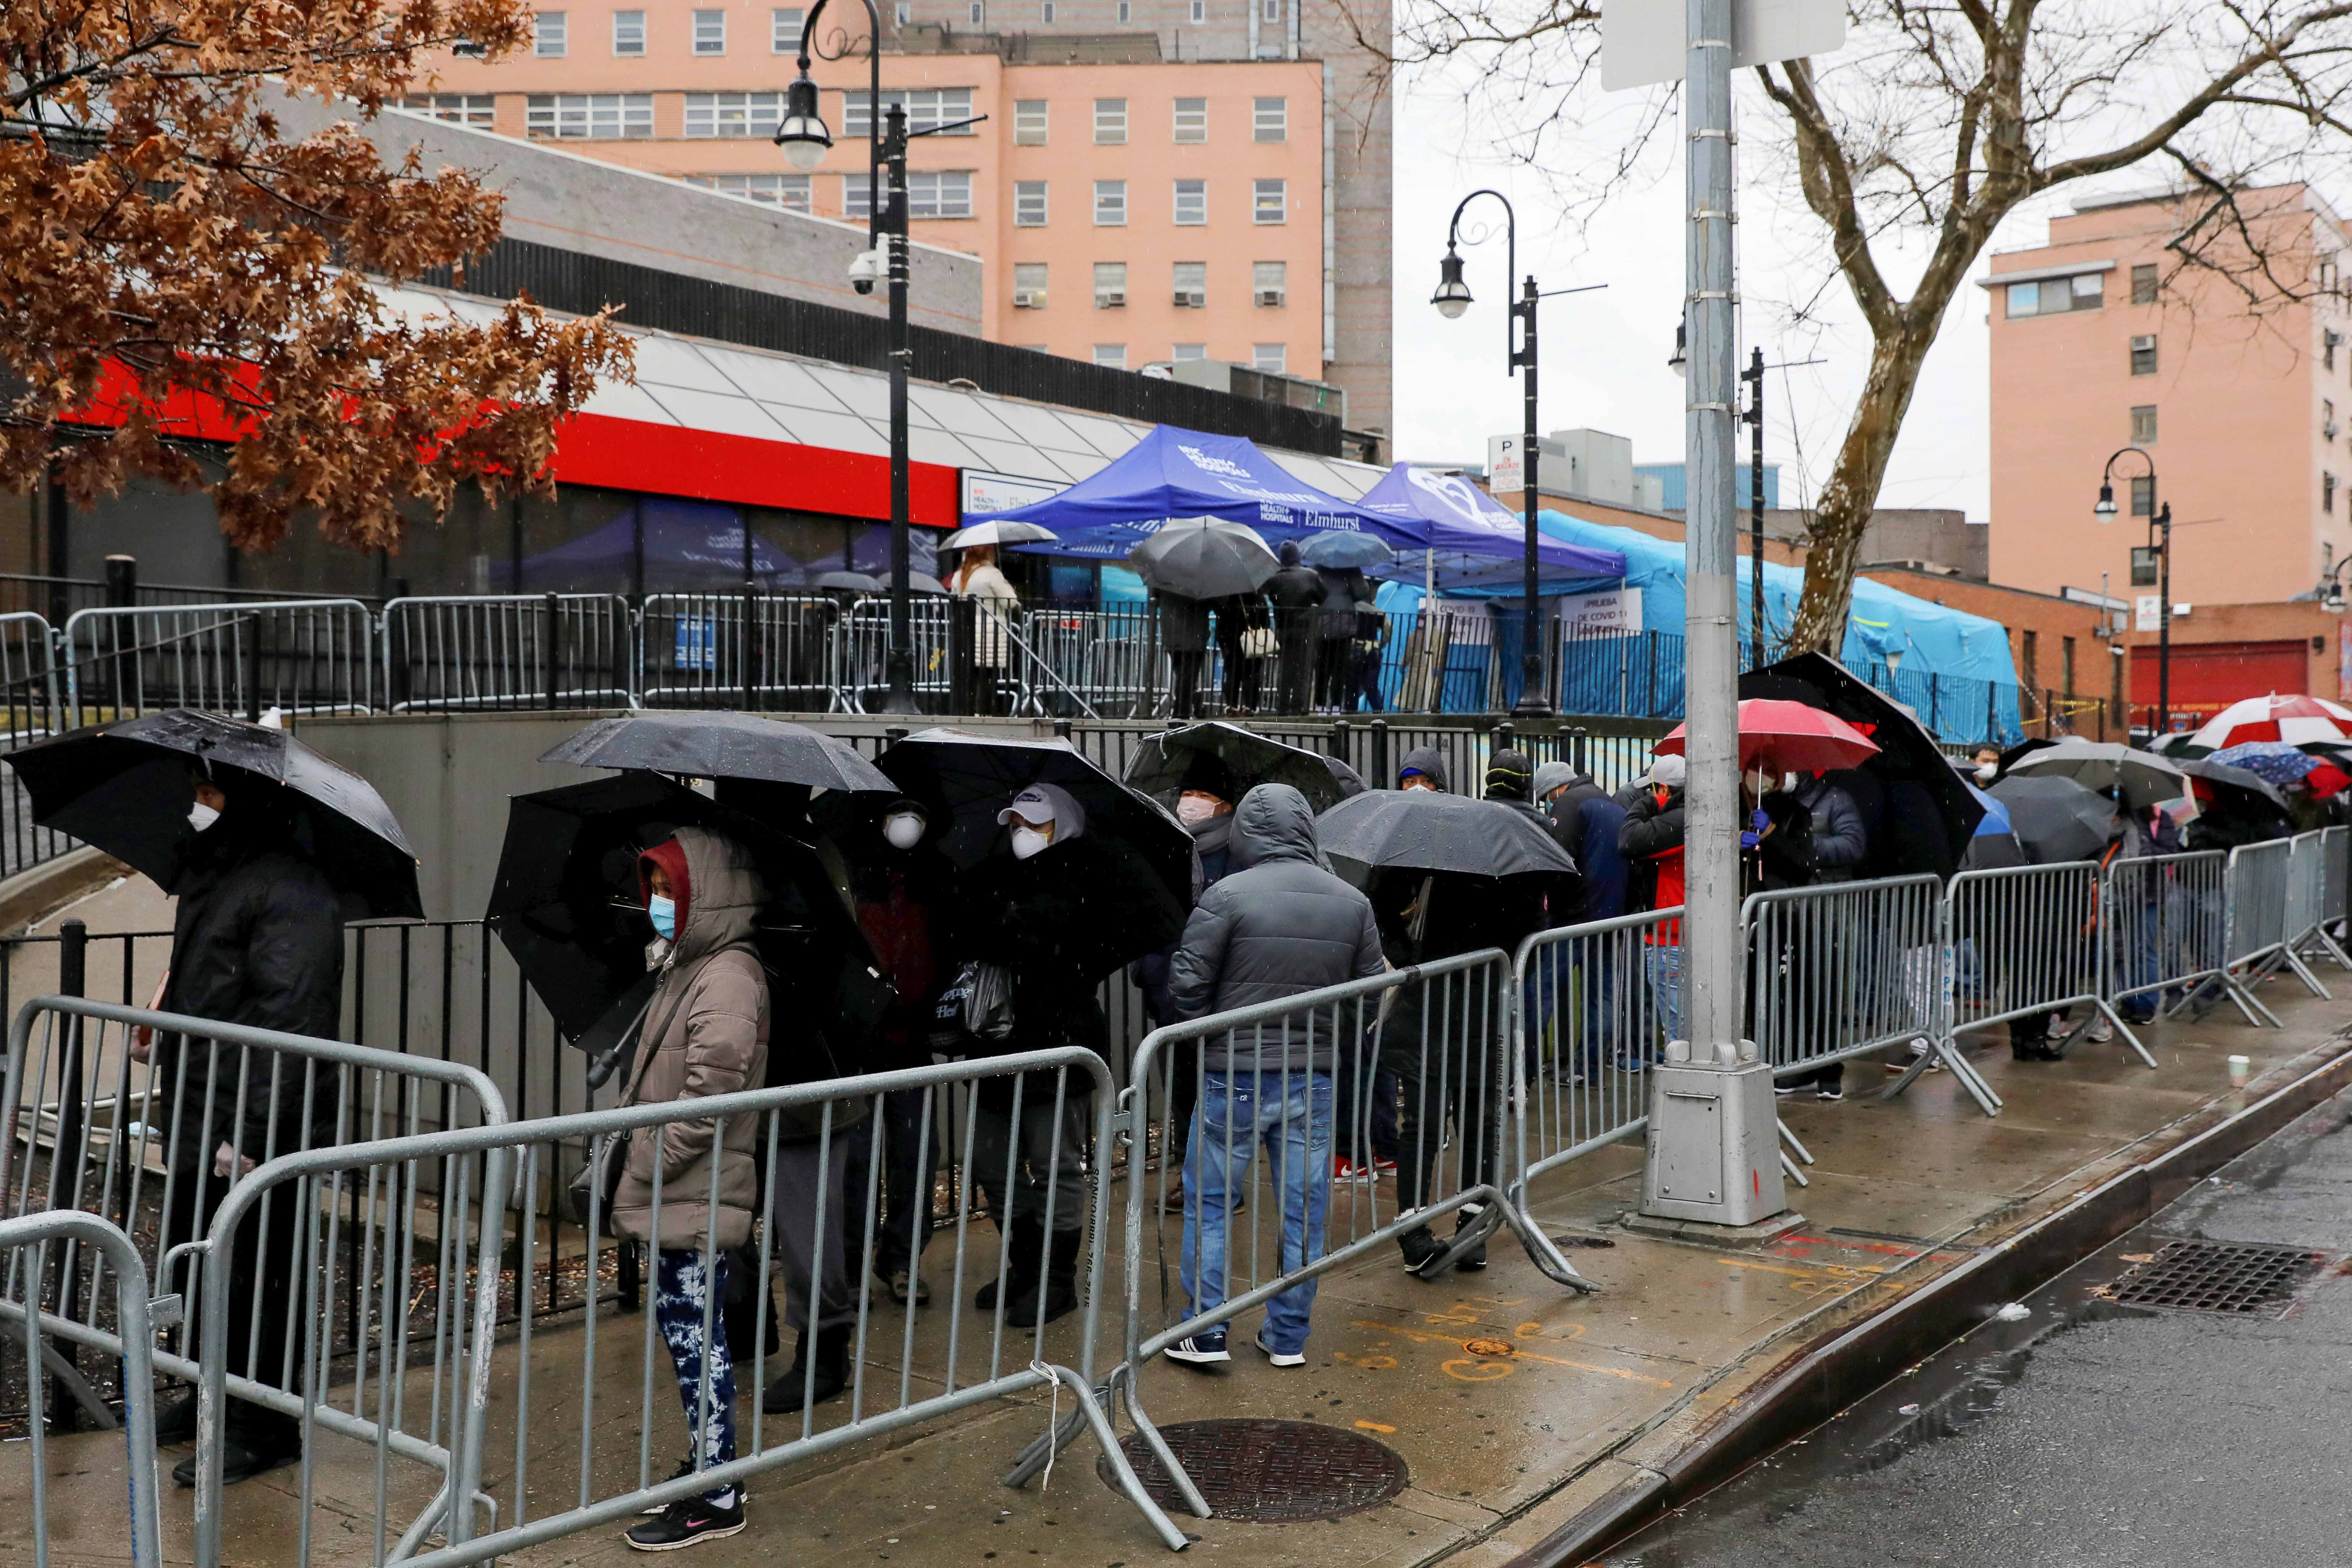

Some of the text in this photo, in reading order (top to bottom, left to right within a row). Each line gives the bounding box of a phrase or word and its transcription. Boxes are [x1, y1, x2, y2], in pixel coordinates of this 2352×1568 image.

[1503, 441, 1512, 452] P
[1260, 512, 1294, 524] HOSPITALS
[1305, 509, 1361, 531] Elmhurst
[1577, 613, 1588, 622] DE
[1591, 610, 1616, 621] COVID
